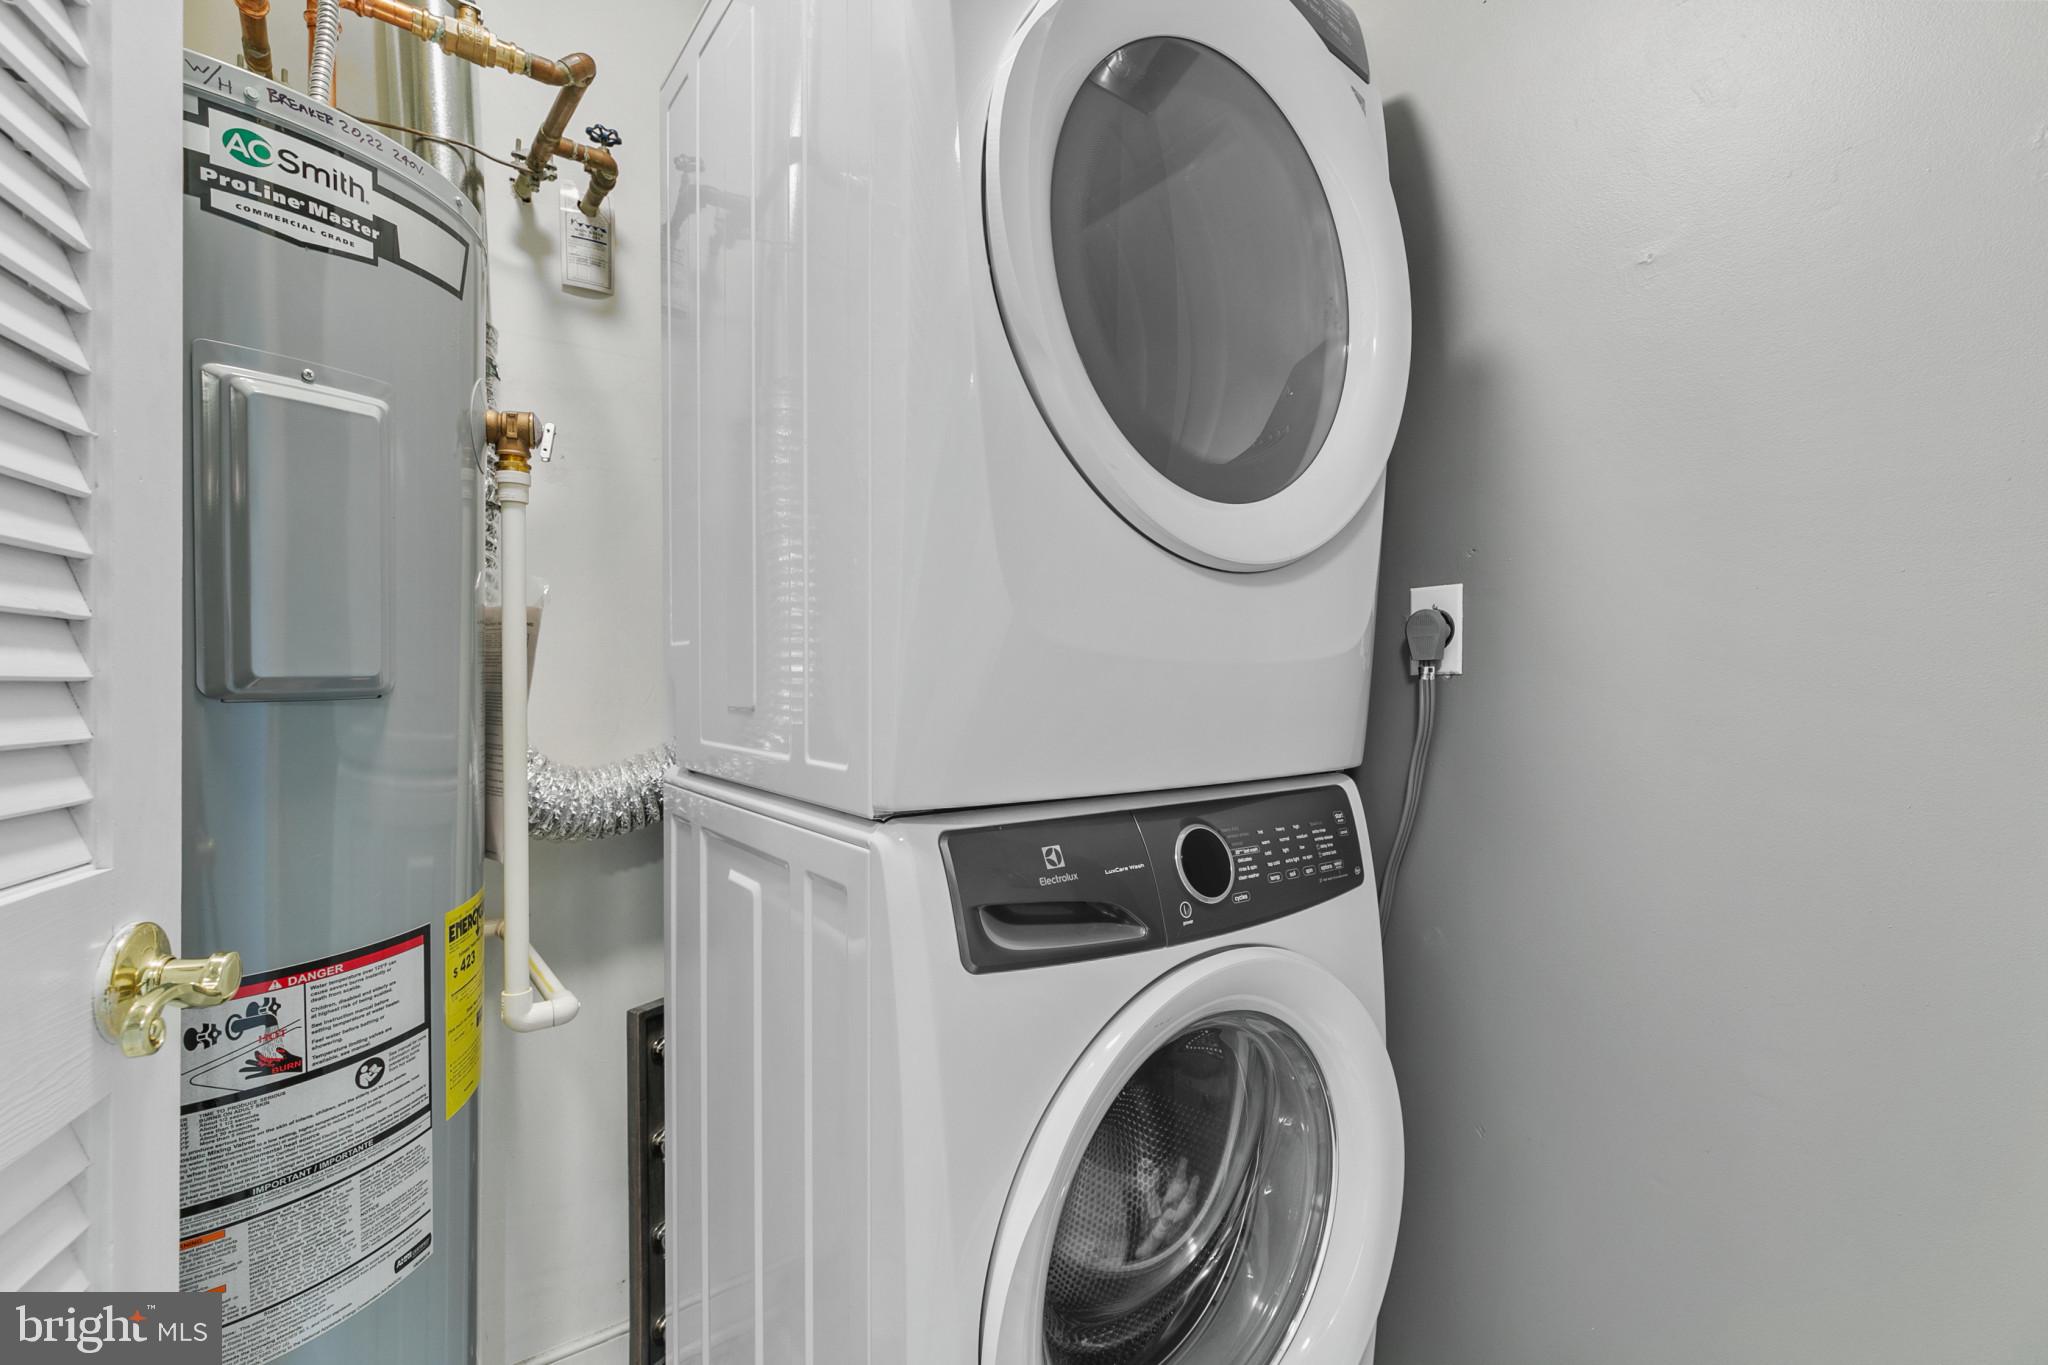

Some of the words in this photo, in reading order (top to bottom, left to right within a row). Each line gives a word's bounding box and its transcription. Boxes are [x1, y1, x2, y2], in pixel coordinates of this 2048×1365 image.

[184, 58, 232, 95] W/H
[266, 87, 334, 126] BREAKER
[278, 149, 365, 203] Smith
[200, 167, 305, 210] ProLine
[308, 202, 380, 240] Master
[235, 203, 315, 233] COMMERCIAL
[320, 229, 355, 248] GRADE
[1039, 872, 1079, 886] Electrolux
[288, 964, 344, 987] DANGER
[272, 1060, 301, 1074] BURN
[199, 1111, 214, 1119] TIME
[227, 1099, 258, 1112] PRODUCE
[199, 1115, 221, 1123] BURNS
[207, 1147, 232, 1157] Mixing
[234, 1140, 256, 1149] Valves
[252, 1167, 312, 1195] IMPORTANT
[319, 1142, 374, 1170] IMPORTANTE
